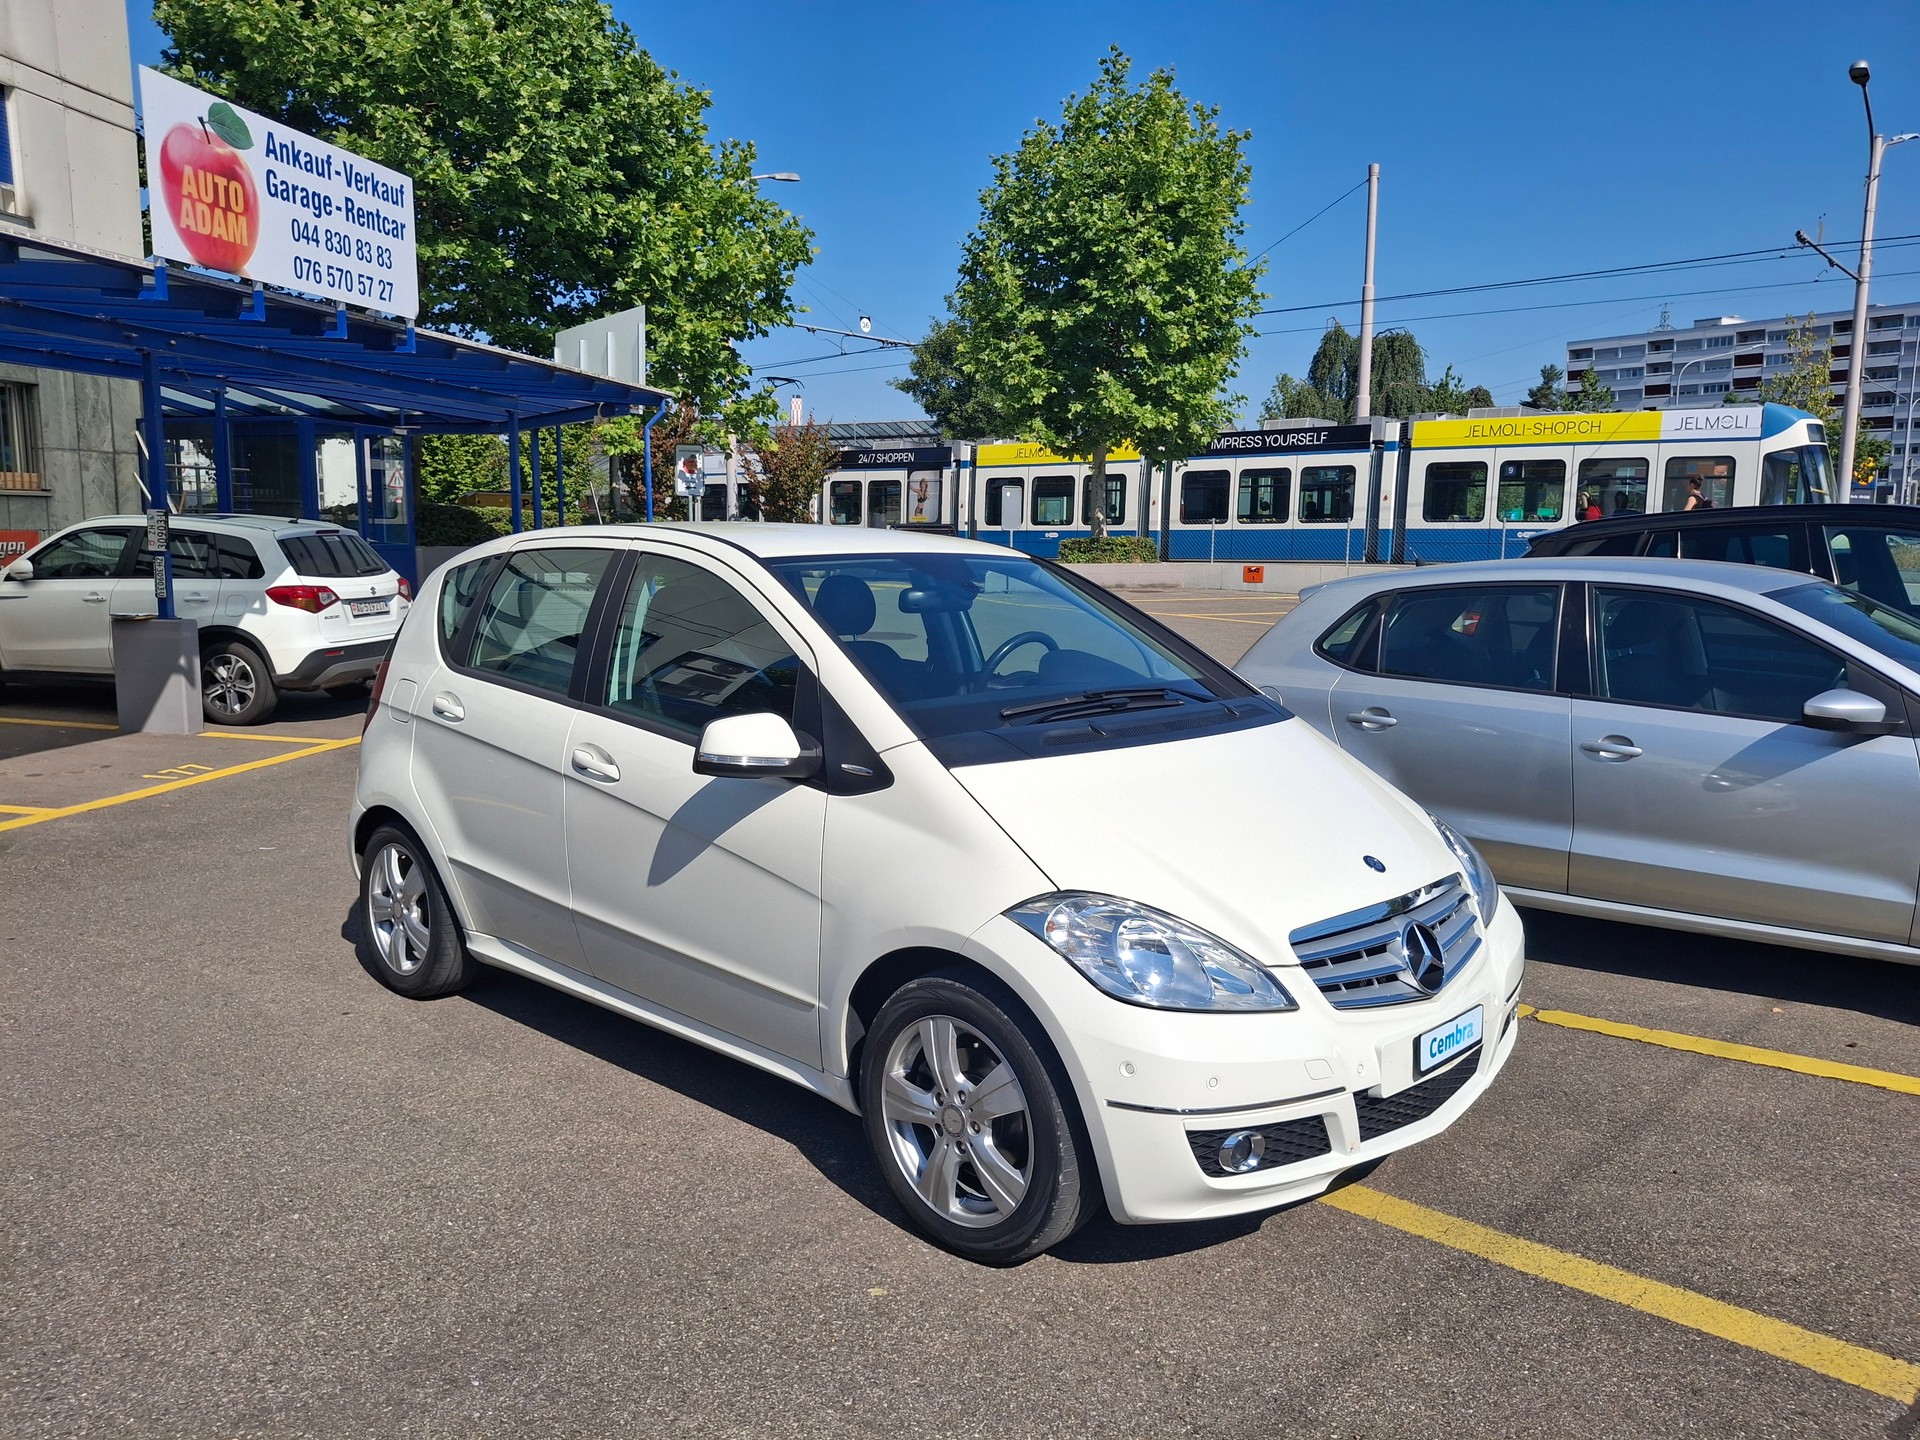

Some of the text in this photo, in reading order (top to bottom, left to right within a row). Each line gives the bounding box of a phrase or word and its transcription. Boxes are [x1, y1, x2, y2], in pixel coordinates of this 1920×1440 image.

[181, 165, 245, 213] AUTO
[265, 130, 405, 208] Ankauf-Verkauf
[180, 197, 248, 247] ADAM
[265, 169, 406, 241] Garage-Rentcar
[291, 218, 392, 269] 044 830 83 83
[293, 255, 394, 303] 076 570 57 27
[1211, 431, 1329, 450] IMPRESS YOURSELF
[1464, 420, 1602, 438] JELMOLI-SHOP.CH
[1674, 414, 1749, 431] JELMOLI
[858, 452, 915, 464] 24/7 SHOPPEN
[1429, 1022, 1474, 1058] Cembra
